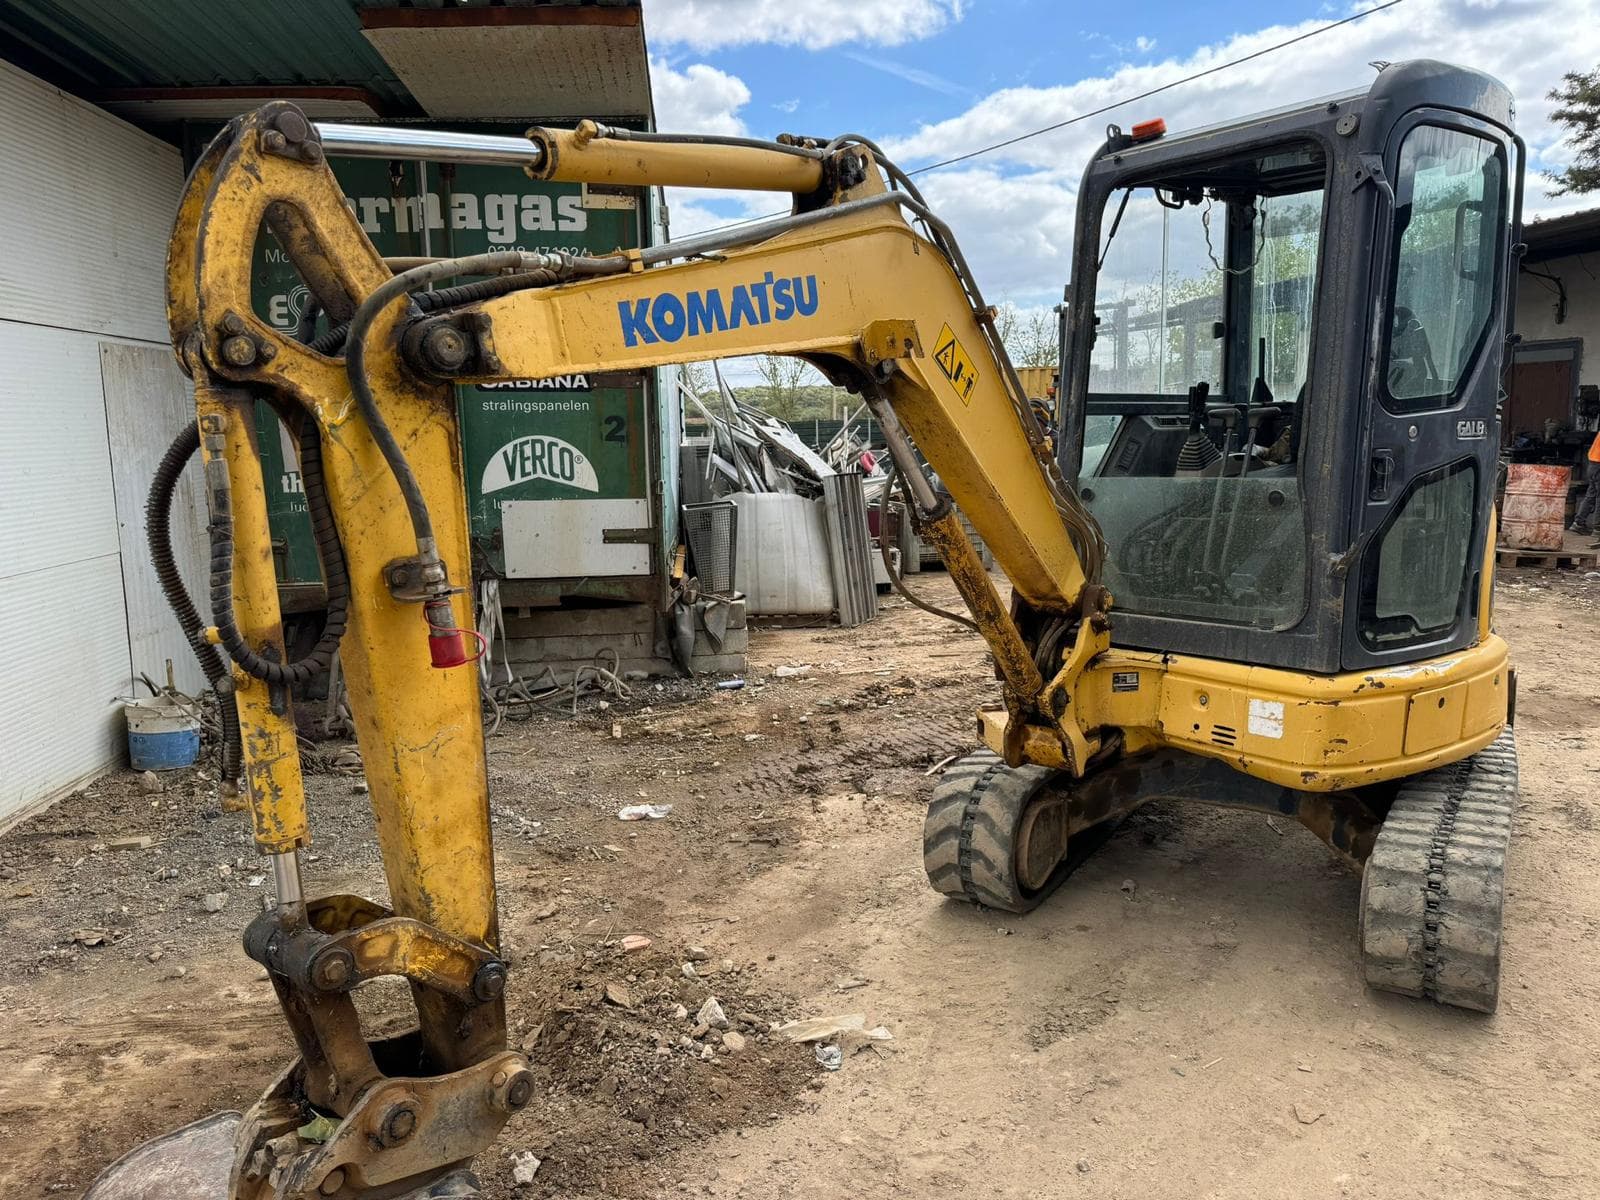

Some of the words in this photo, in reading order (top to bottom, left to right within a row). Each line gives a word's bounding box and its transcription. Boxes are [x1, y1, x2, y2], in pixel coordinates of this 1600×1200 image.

[617, 271, 819, 347] KOMATSU
[482, 400, 590, 413] stralingspanelen
[604, 415, 626, 443] 2
